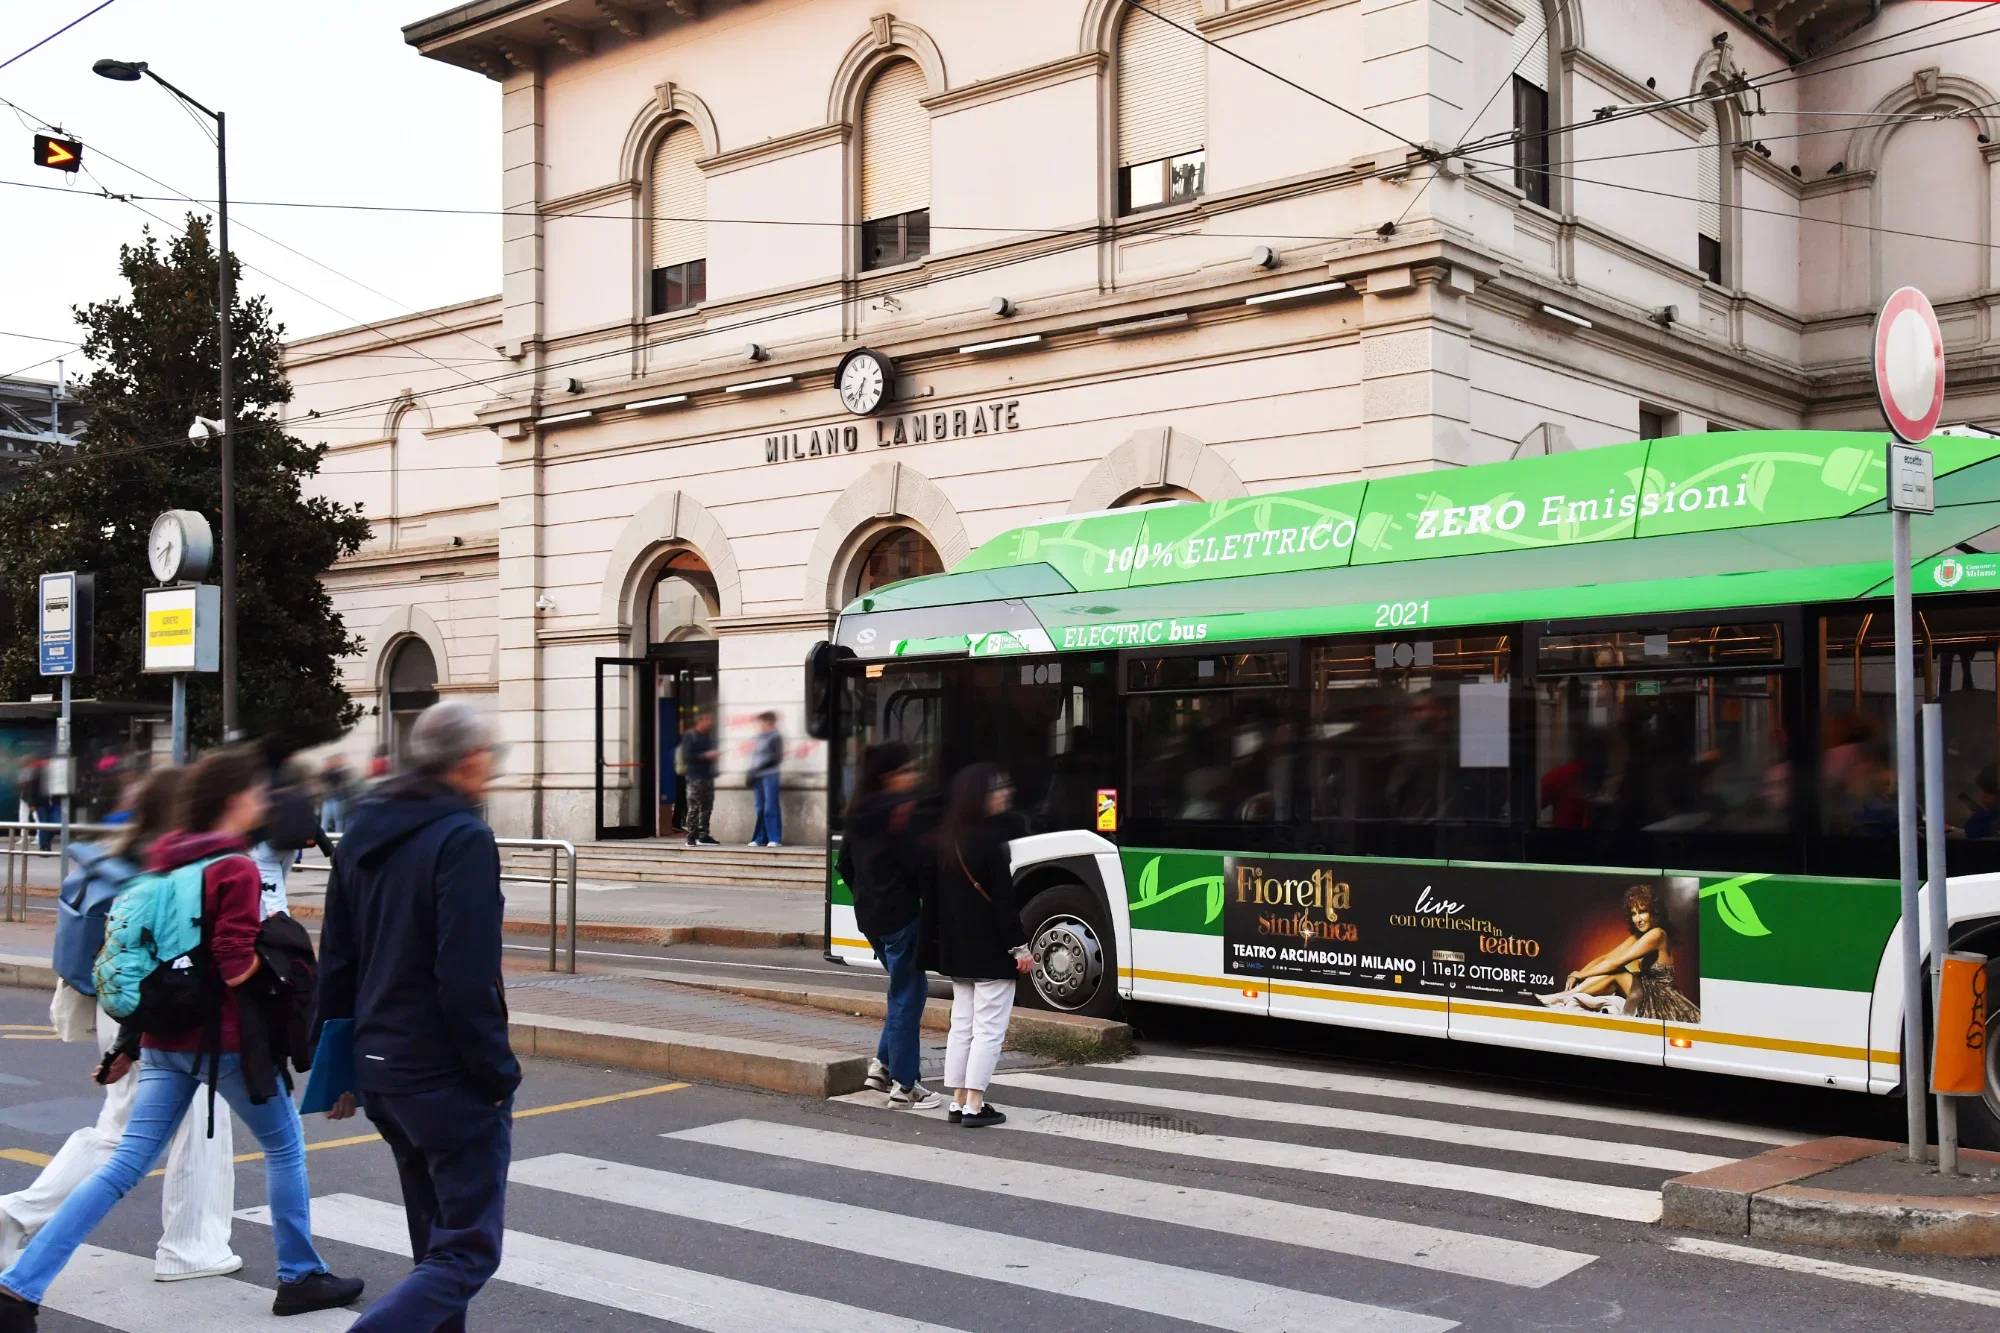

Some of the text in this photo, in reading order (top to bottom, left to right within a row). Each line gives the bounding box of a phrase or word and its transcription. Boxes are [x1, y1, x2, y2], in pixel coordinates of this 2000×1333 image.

[765, 400, 1020, 463] MILANO LAMBRATE
[1414, 473, 1748, 540] ZERO Emissioni
[1104, 520, 1357, 574] 100% ELETTRICO
[1965, 569, 1997, 577] Milano
[1375, 600, 1430, 628] 2021
[1063, 621, 1207, 648] ELECTRIC bus
[1236, 866, 1351, 922] Fiorella
[1415, 885, 1465, 915] live
[1258, 909, 1359, 947] Sinfonica
[1389, 912, 1503, 937] con orchestra in
[1479, 934, 1540, 958] teatro
[1233, 943, 1277, 960] TEATRO
[1279, 947, 1357, 967] ARCIMBOLDI
[1361, 954, 1417, 973] MILANO
[1469, 965, 1527, 984] OTTOBRE
[1530, 973, 1555, 986] 2024
